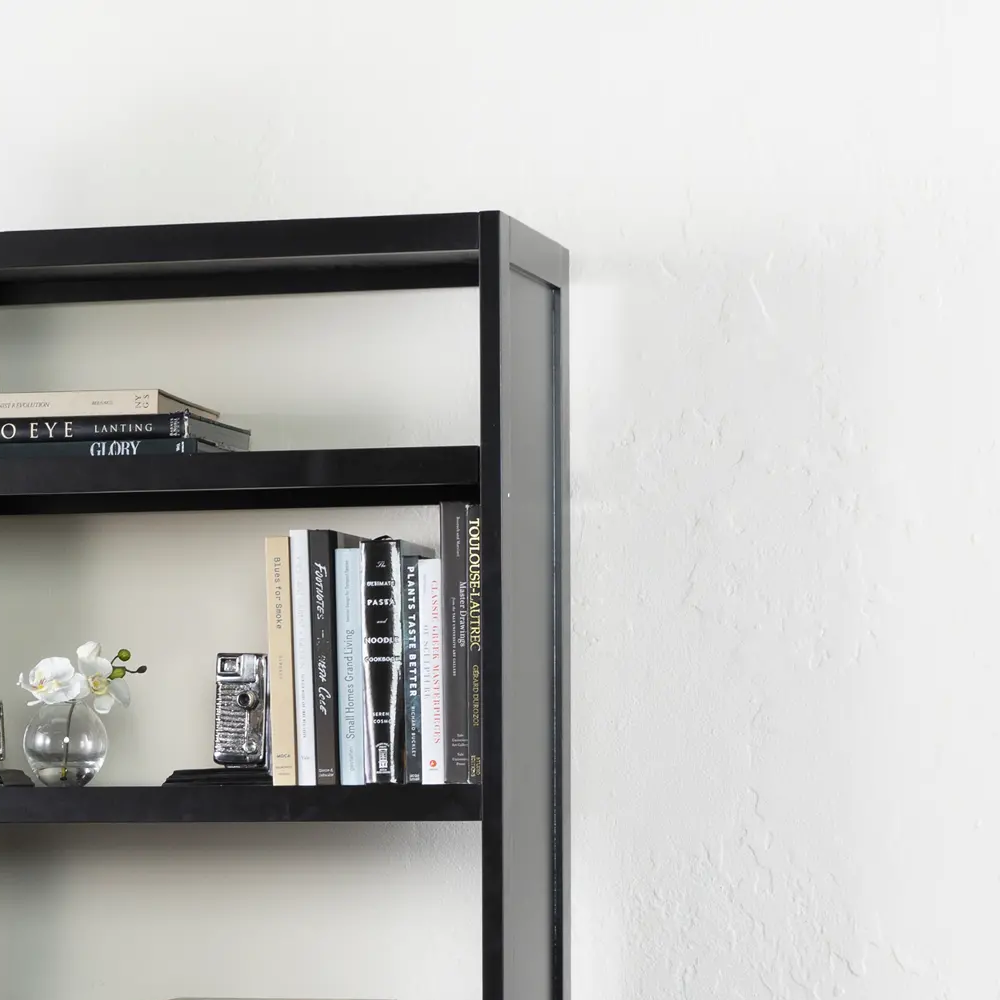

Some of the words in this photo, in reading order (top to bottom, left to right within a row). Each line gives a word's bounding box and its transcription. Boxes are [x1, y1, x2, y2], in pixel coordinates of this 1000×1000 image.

[29, 421, 74, 439] EYE
[94, 423, 153, 434] LANTING
[90, 440, 141, 456] GLORY
[273, 556, 282, 584] Blues
[274, 586, 282, 601] for
[314, 562, 328, 620] FOOTNOTES
[407, 566, 416, 610] PLANTS
[459, 581, 467, 608] Master
[469, 518, 481, 652] TOULOUSE-LAUTREC
[275, 603, 283, 630] Smoke
[458, 610, 467, 647] Drawings
[344, 629, 354, 655] Living
[408, 614, 416, 649] TASTE
[432, 626, 440, 660] GREEK
[344, 656, 354, 682] Grand
[409, 654, 418, 696] BETTER
[472, 665, 480, 693] GÉRARD
[345, 684, 354, 714] Homes
[433, 664, 441, 744] MASTERPIECES
[346, 716, 355, 740] Small
